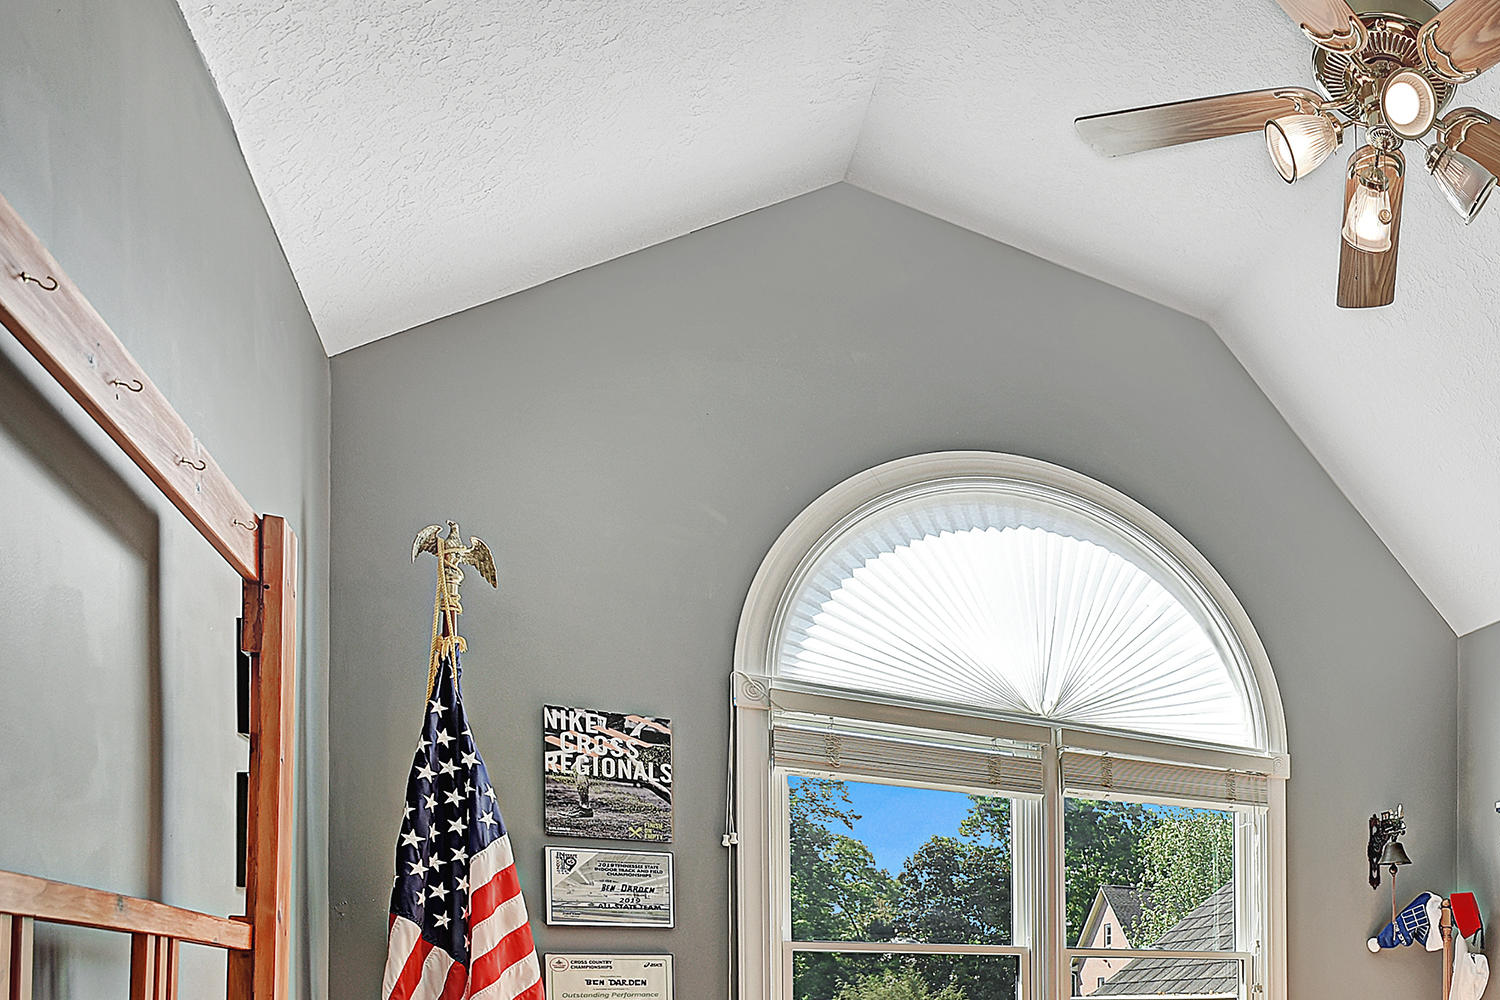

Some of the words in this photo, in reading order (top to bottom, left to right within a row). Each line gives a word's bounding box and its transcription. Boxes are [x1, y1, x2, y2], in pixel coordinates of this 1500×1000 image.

[544, 706, 599, 734] NIKE
[560, 731, 640, 759] CROSS
[545, 751, 672, 784] REGIONALS
[601, 884, 616, 892] BEN
[621, 884, 655, 893] DARDEN
